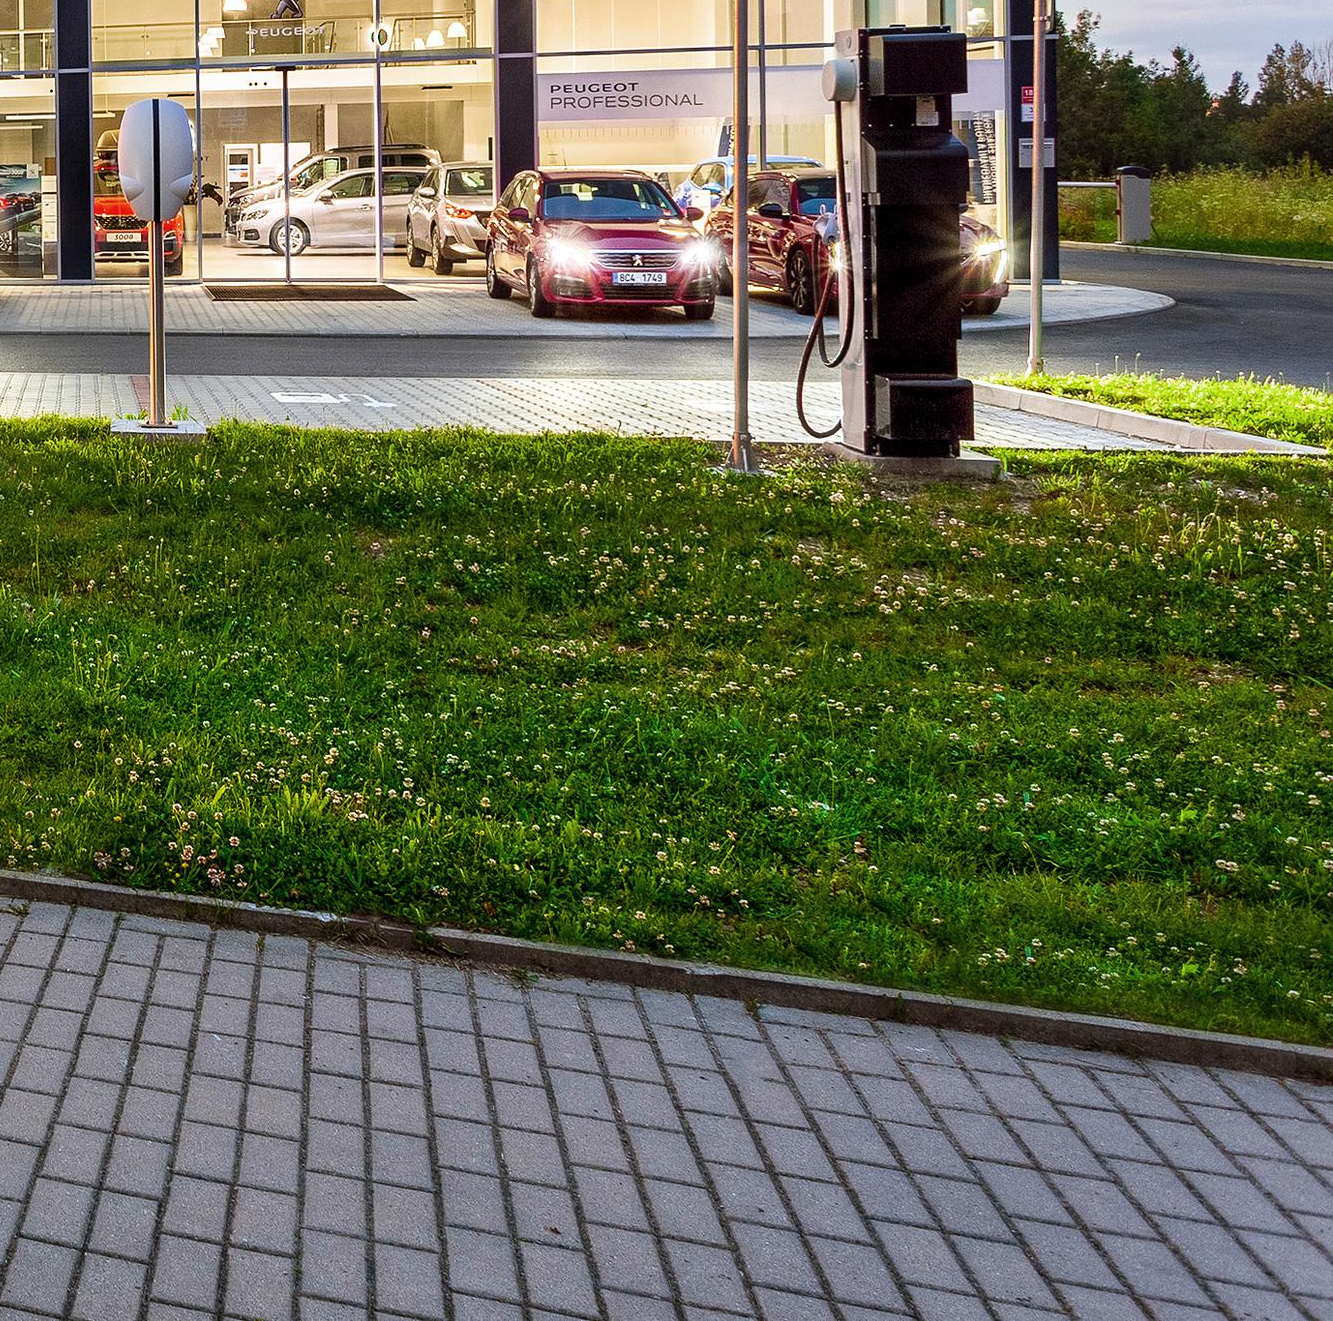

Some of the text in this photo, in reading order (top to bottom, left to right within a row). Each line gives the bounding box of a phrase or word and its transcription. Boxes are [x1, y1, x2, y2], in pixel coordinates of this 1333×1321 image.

[248, 25, 325, 37] PEUGEOT
[550, 82, 639, 94] PEUGEOT
[550, 94, 704, 109] PROFESSIONAL
[619, 273, 663, 282] 8C4 1749
